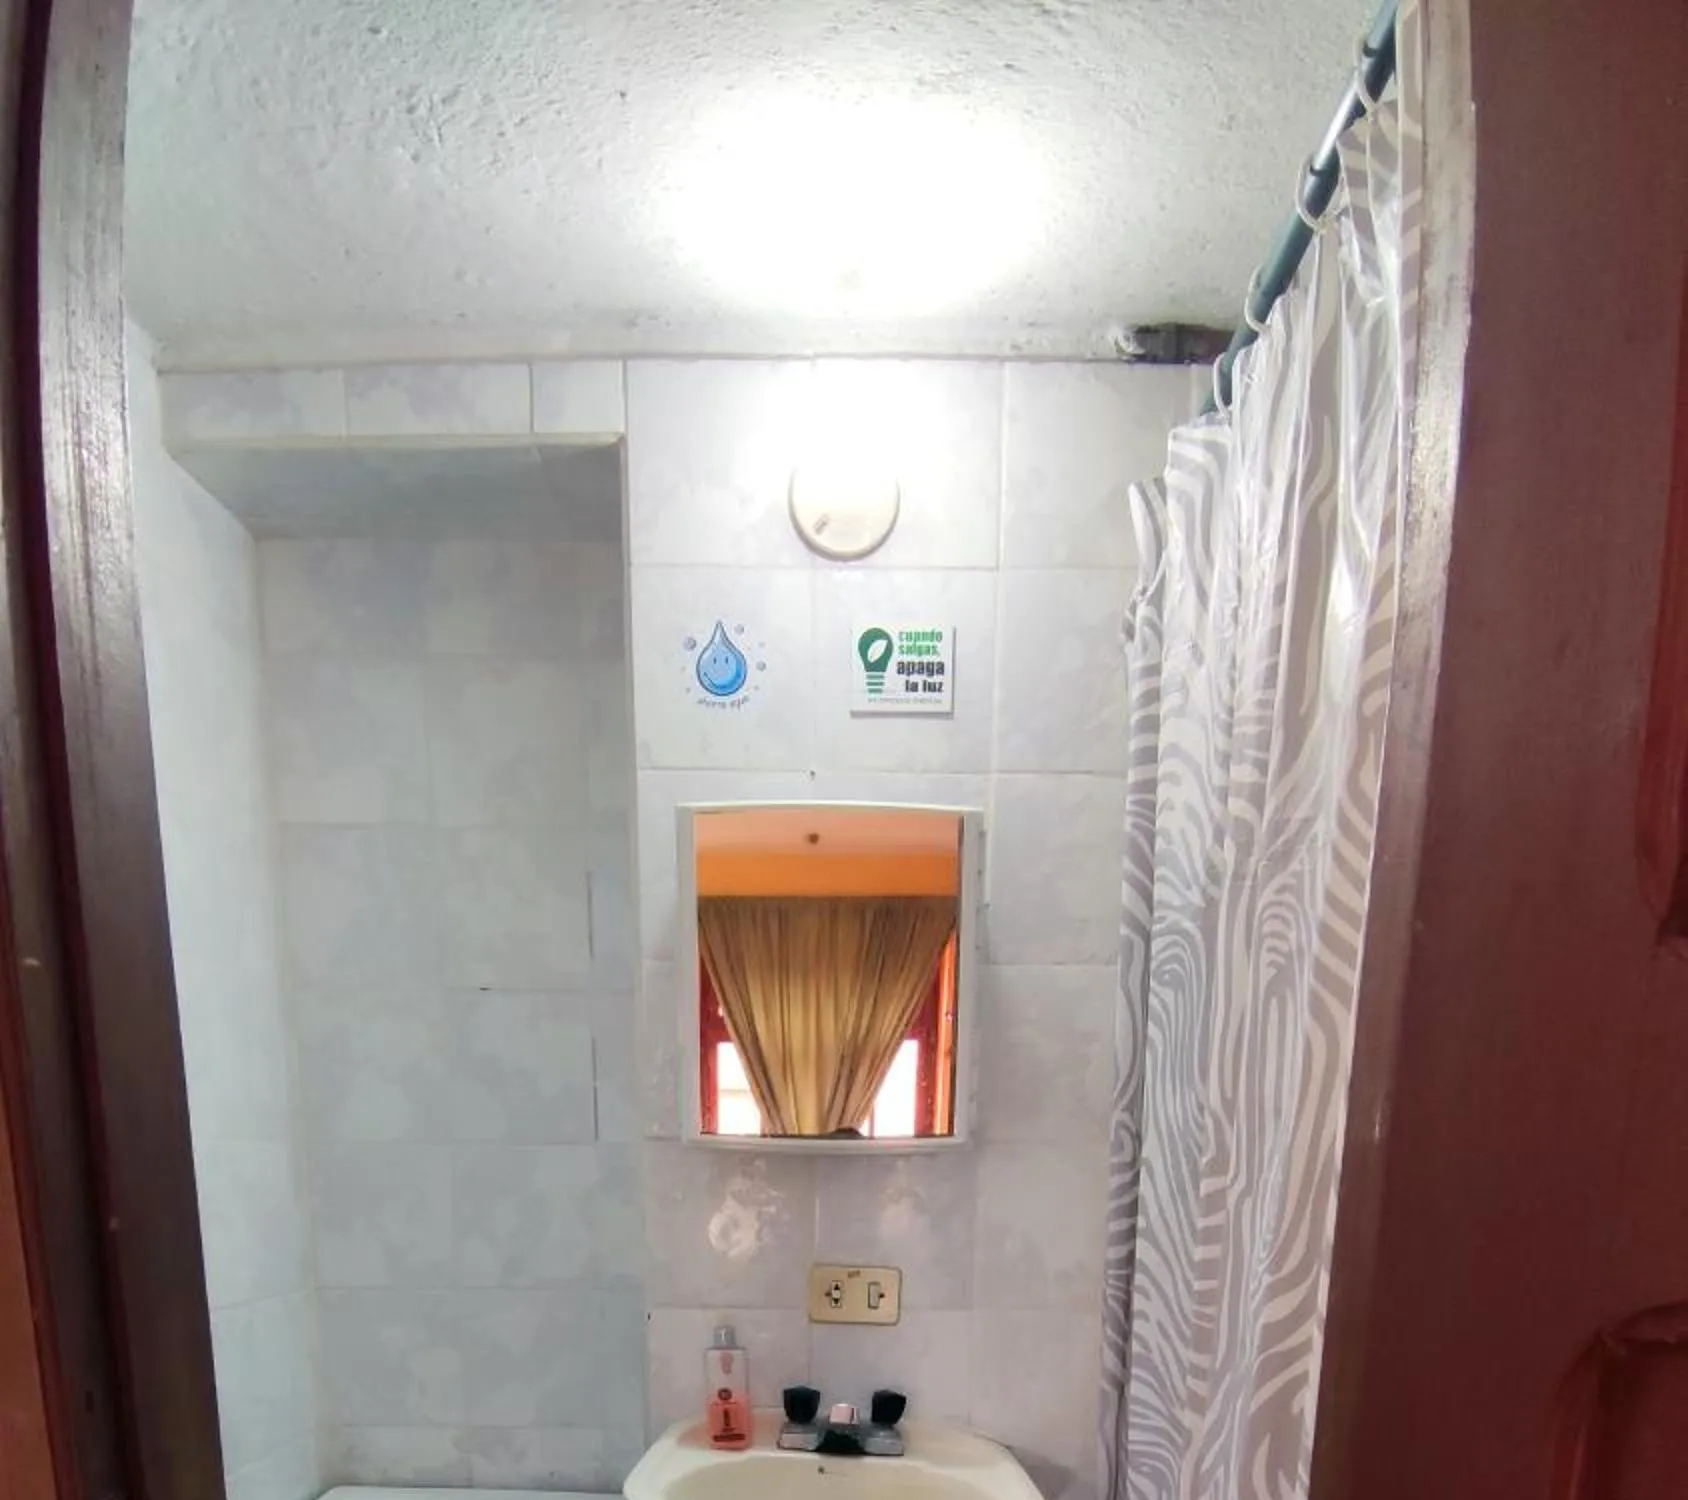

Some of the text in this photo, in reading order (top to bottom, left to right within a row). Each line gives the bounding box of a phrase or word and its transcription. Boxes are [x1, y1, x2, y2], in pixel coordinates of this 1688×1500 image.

[896, 661, 945, 677] apaga
[905, 680, 943, 693] la luz
